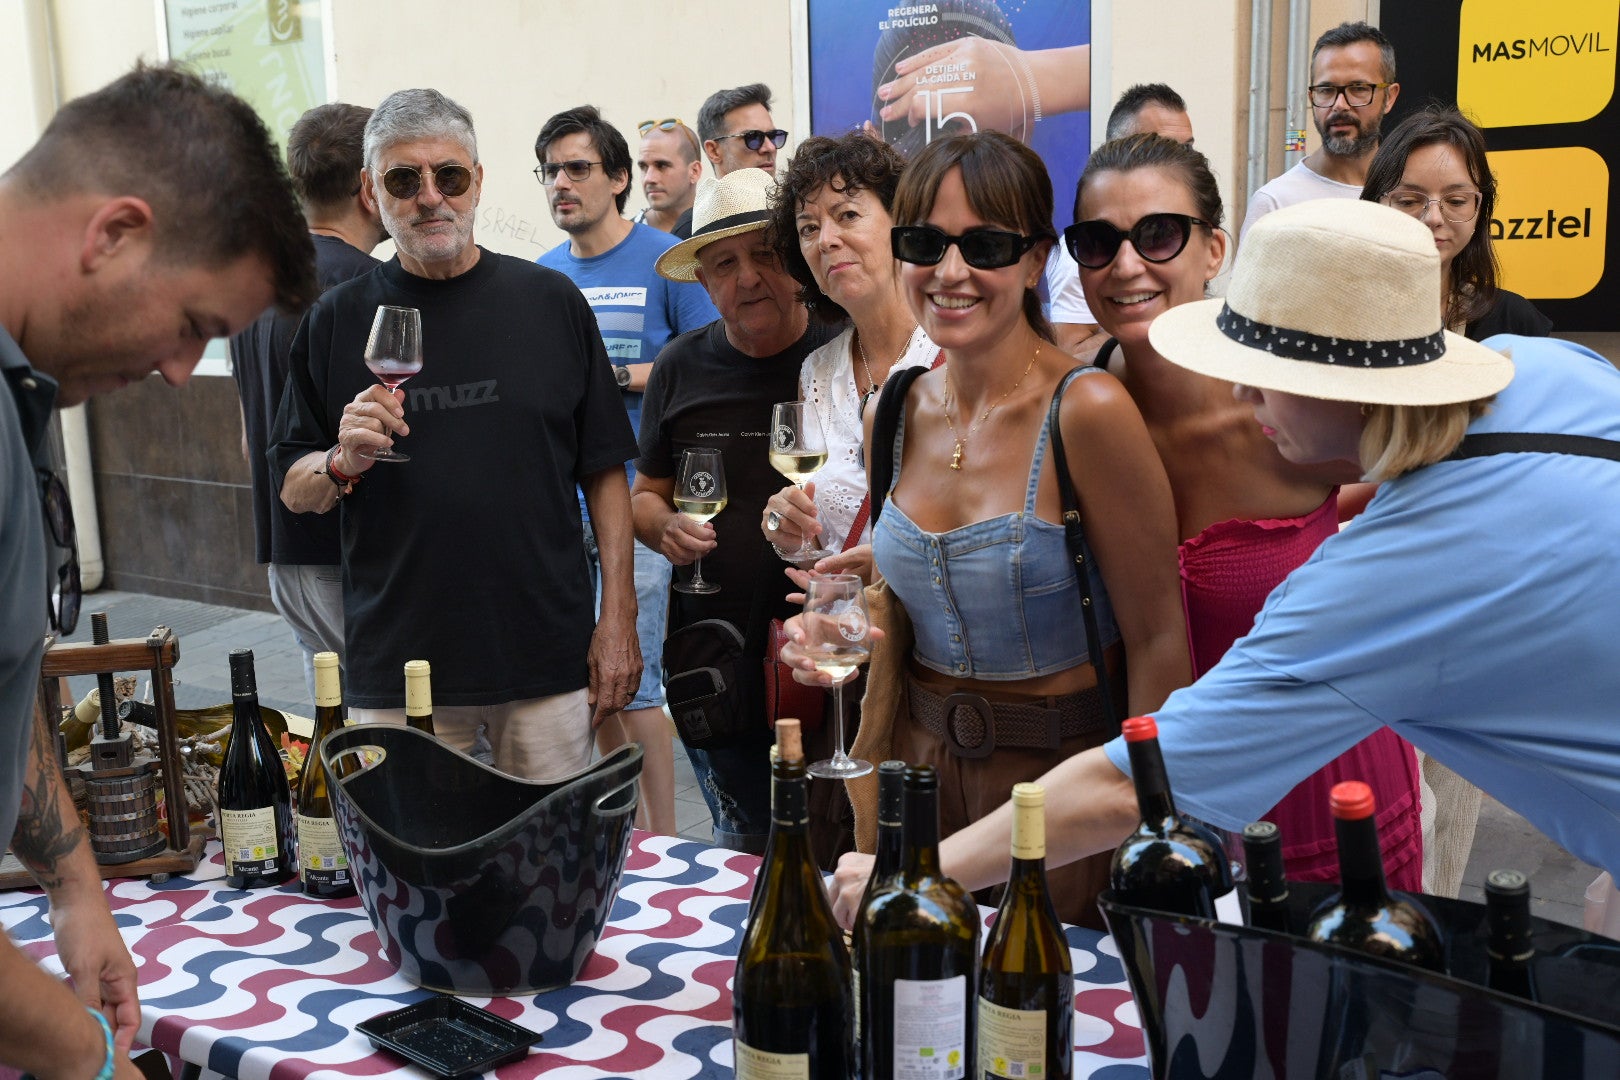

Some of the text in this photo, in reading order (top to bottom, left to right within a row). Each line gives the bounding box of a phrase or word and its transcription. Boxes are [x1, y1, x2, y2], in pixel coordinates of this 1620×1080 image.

[888, 4, 938, 17] REGENERA
[879, 15, 939, 30] EL FOLÍCULO
[1472, 32, 1610, 63] MASMOVIL
[925, 63, 967, 75] DETIENE
[916, 76, 928, 85] LA
[962, 72, 976, 81] EN
[1490, 208, 1591, 240] azztel
[409, 379, 500, 412] muzz
